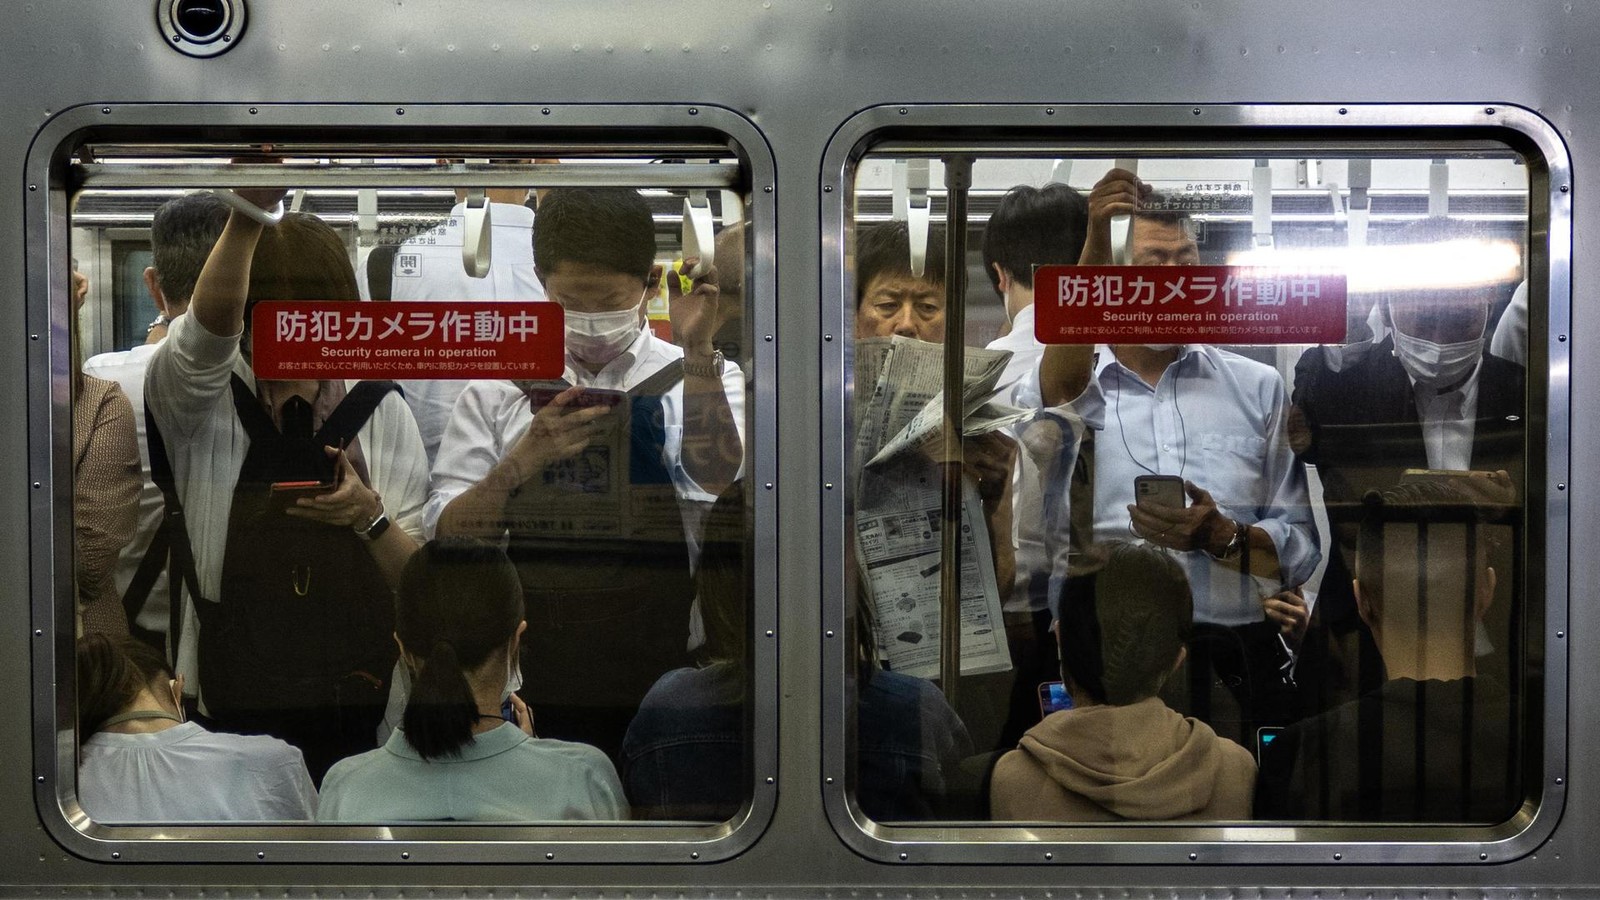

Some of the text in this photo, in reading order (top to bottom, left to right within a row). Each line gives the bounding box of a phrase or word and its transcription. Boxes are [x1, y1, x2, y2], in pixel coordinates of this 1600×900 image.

[1057, 274, 1321, 307] 防犯カメラ作動中
[276, 310, 539, 343] 防犯カメラ作動中
[1102, 310, 1279, 323] Security camera in operation
[321, 346, 497, 359] Security camera in operation
